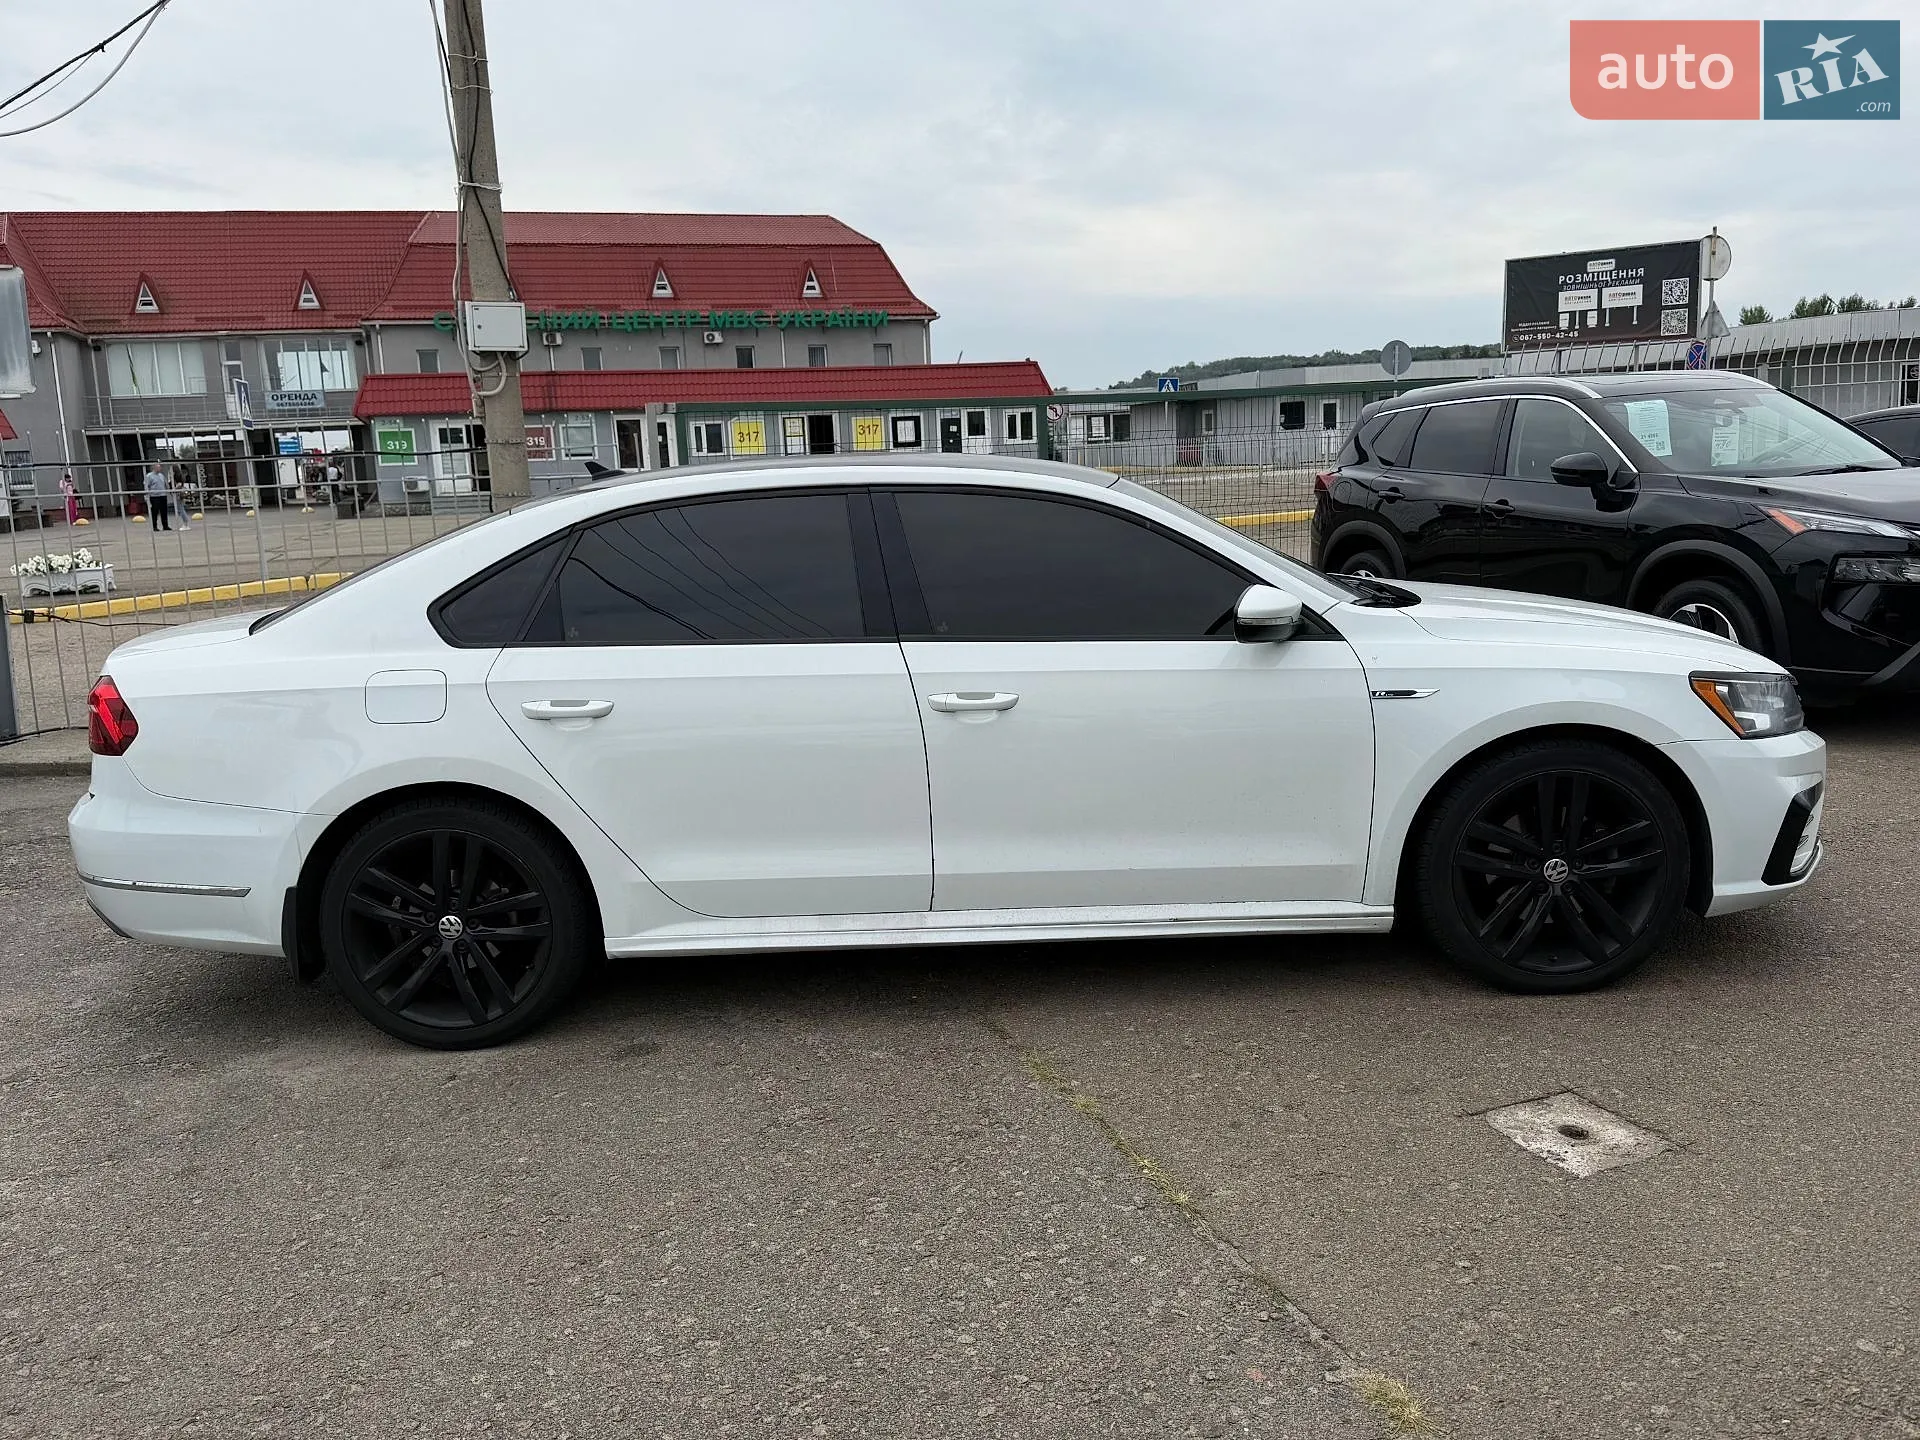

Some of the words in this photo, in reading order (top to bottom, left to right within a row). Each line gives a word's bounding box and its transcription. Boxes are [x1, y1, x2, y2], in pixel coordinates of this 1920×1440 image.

[1558, 268, 1644, 285] РОЗМІЩЕННЯ
[610, 309, 701, 333] ЦЕНТР
[708, 309, 768, 329] МВС
[776, 307, 889, 329] УКРАЇНИ
[271, 392, 318, 402] ОРЕНДА
[857, 424, 879, 437] 317
[526, 436, 546, 446] 319
[737, 431, 760, 443] 317
